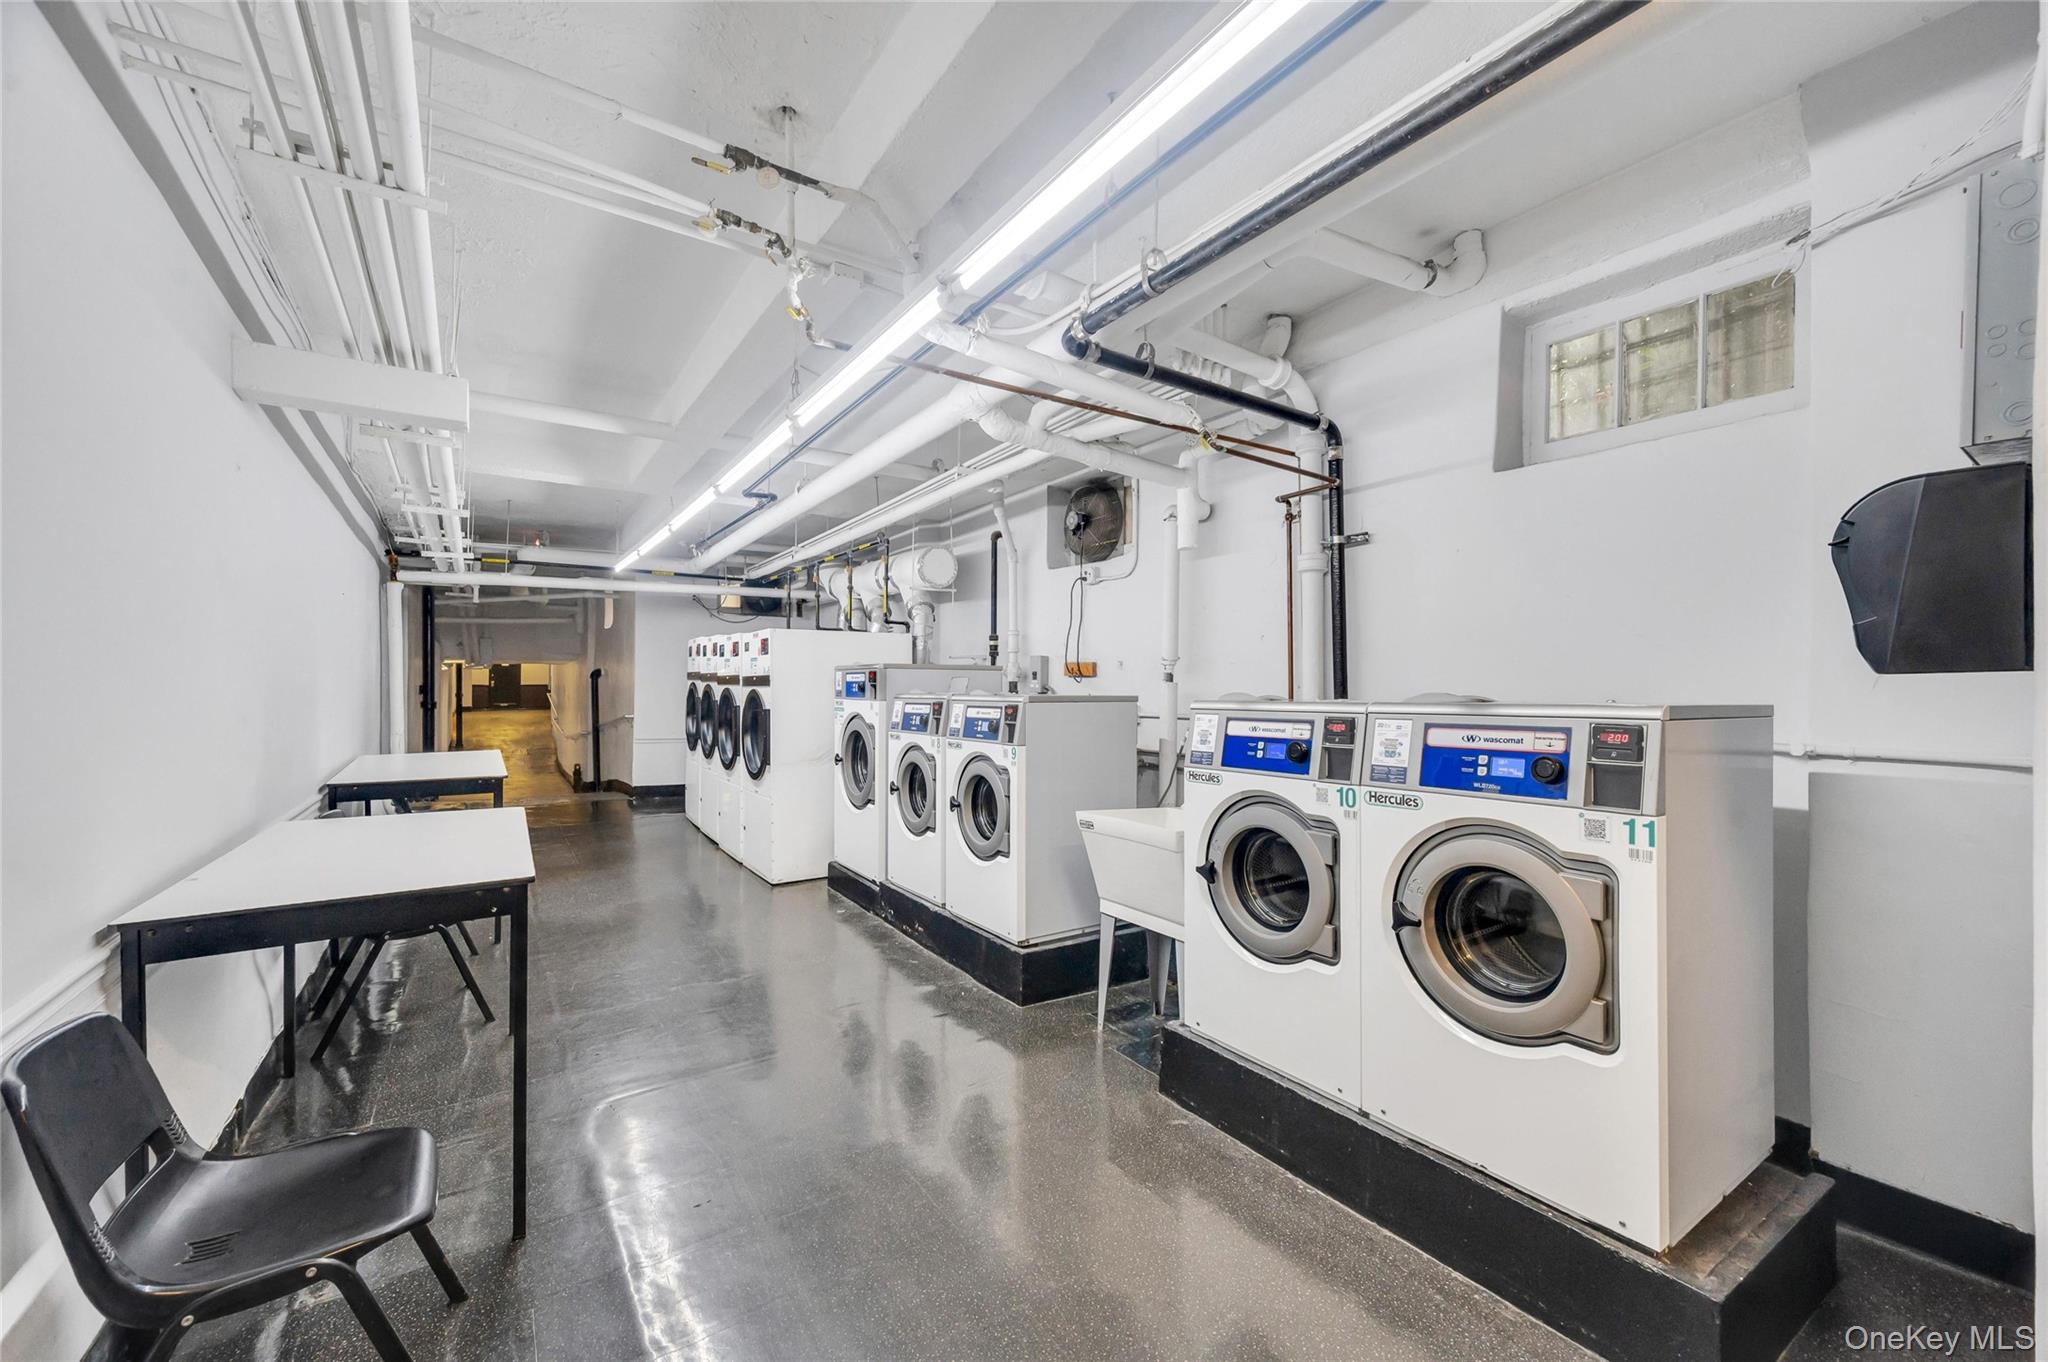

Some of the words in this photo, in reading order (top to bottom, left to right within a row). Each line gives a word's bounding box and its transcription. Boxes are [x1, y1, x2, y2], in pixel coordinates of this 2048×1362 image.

[1483, 736, 1524, 745] wascomat
[1011, 747, 1017, 760] 9
[1188, 770, 1221, 784] Hercules
[1336, 786, 1357, 809] 10
[1368, 791, 1420, 808] Hercules
[1622, 818, 1656, 848] 11
